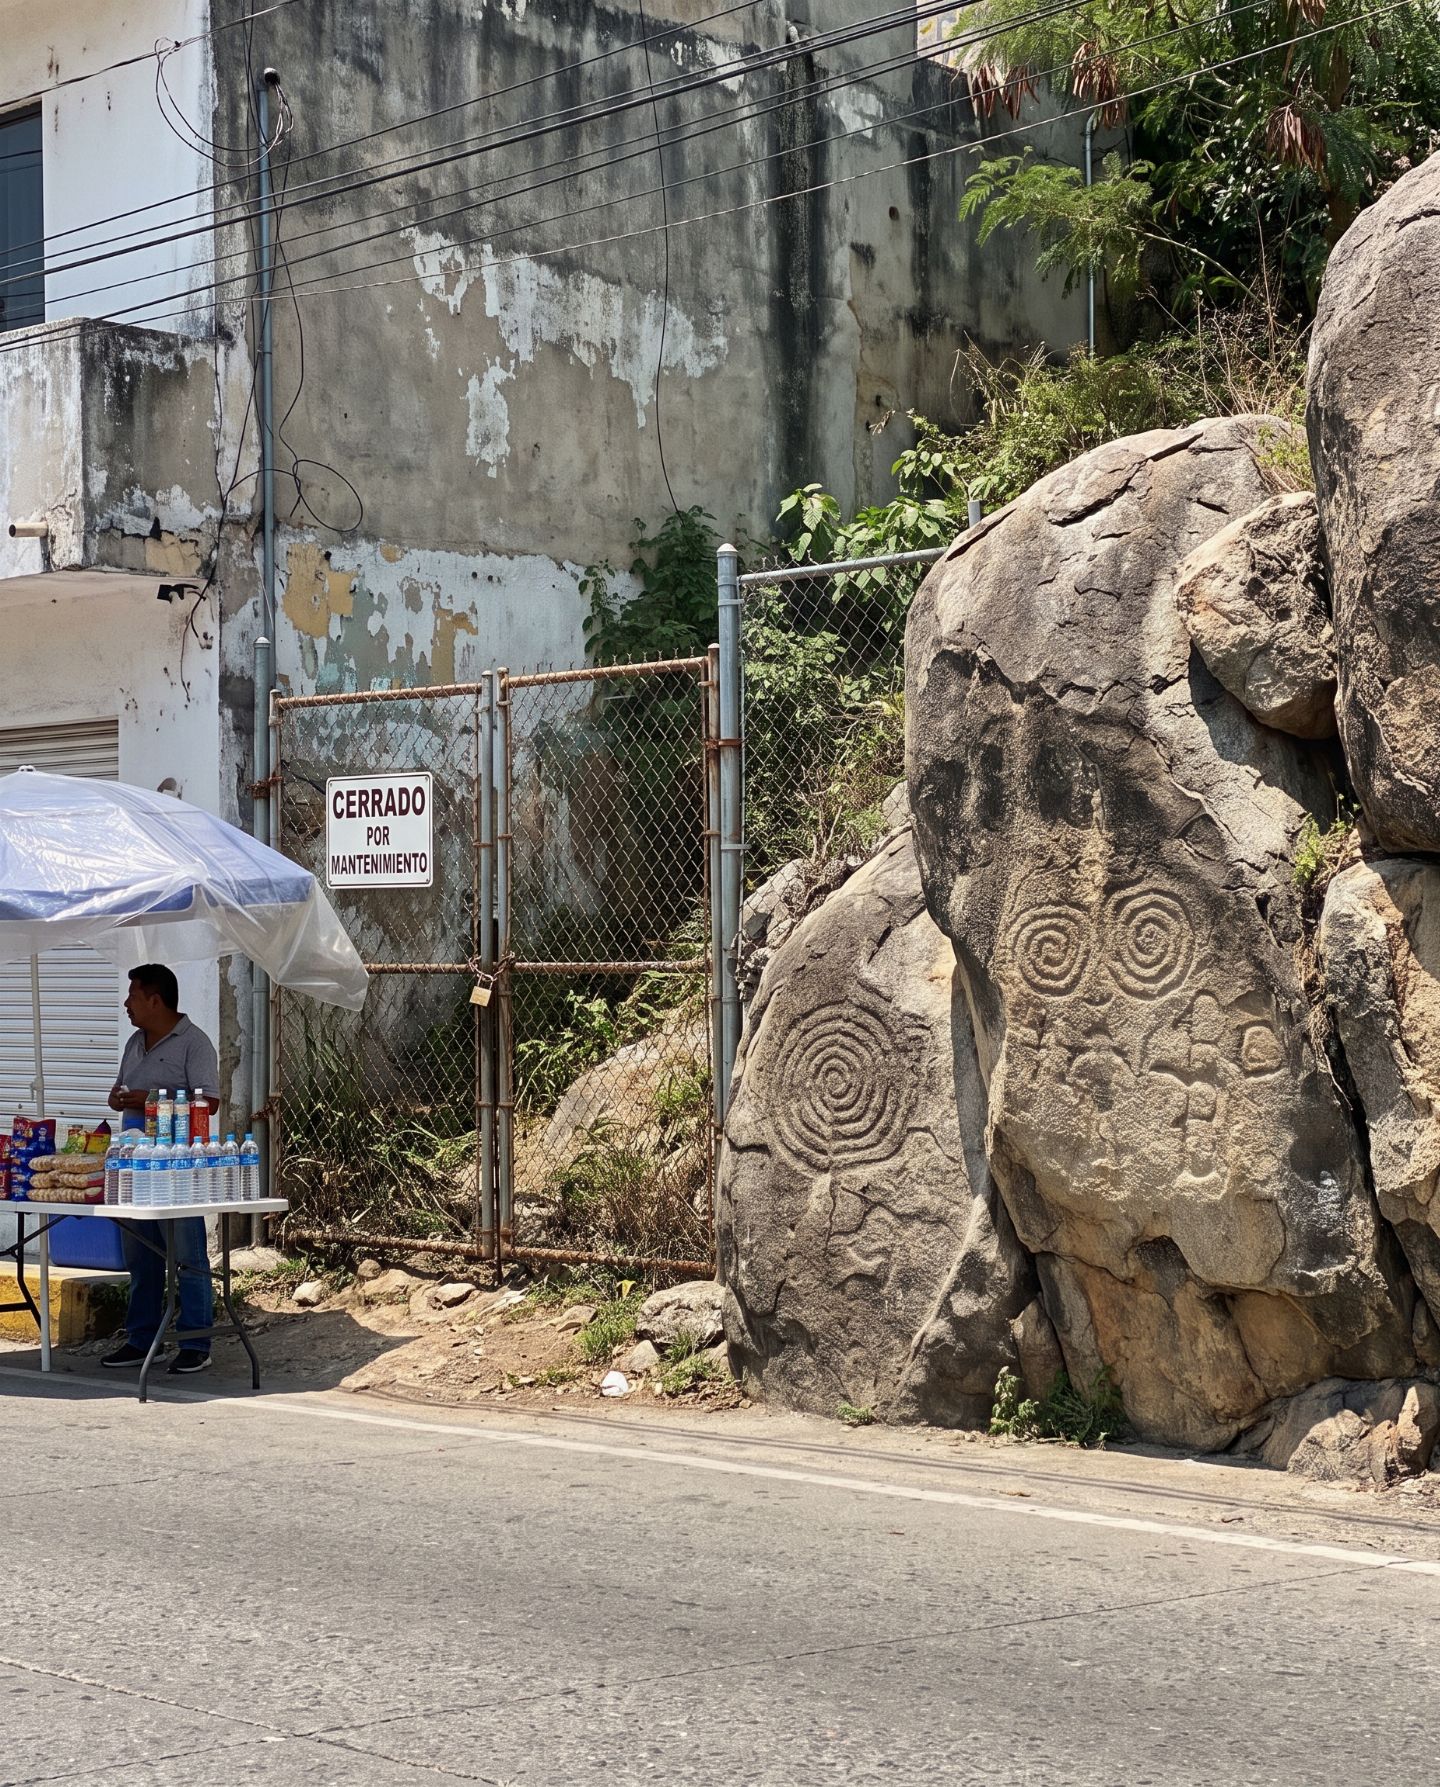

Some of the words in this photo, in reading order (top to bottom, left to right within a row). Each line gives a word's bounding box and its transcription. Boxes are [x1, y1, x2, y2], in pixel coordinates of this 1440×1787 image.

[332, 786, 426, 819] CERRADO
[366, 826, 390, 846] POR
[331, 852, 428, 875] MANTENIMIENTO
